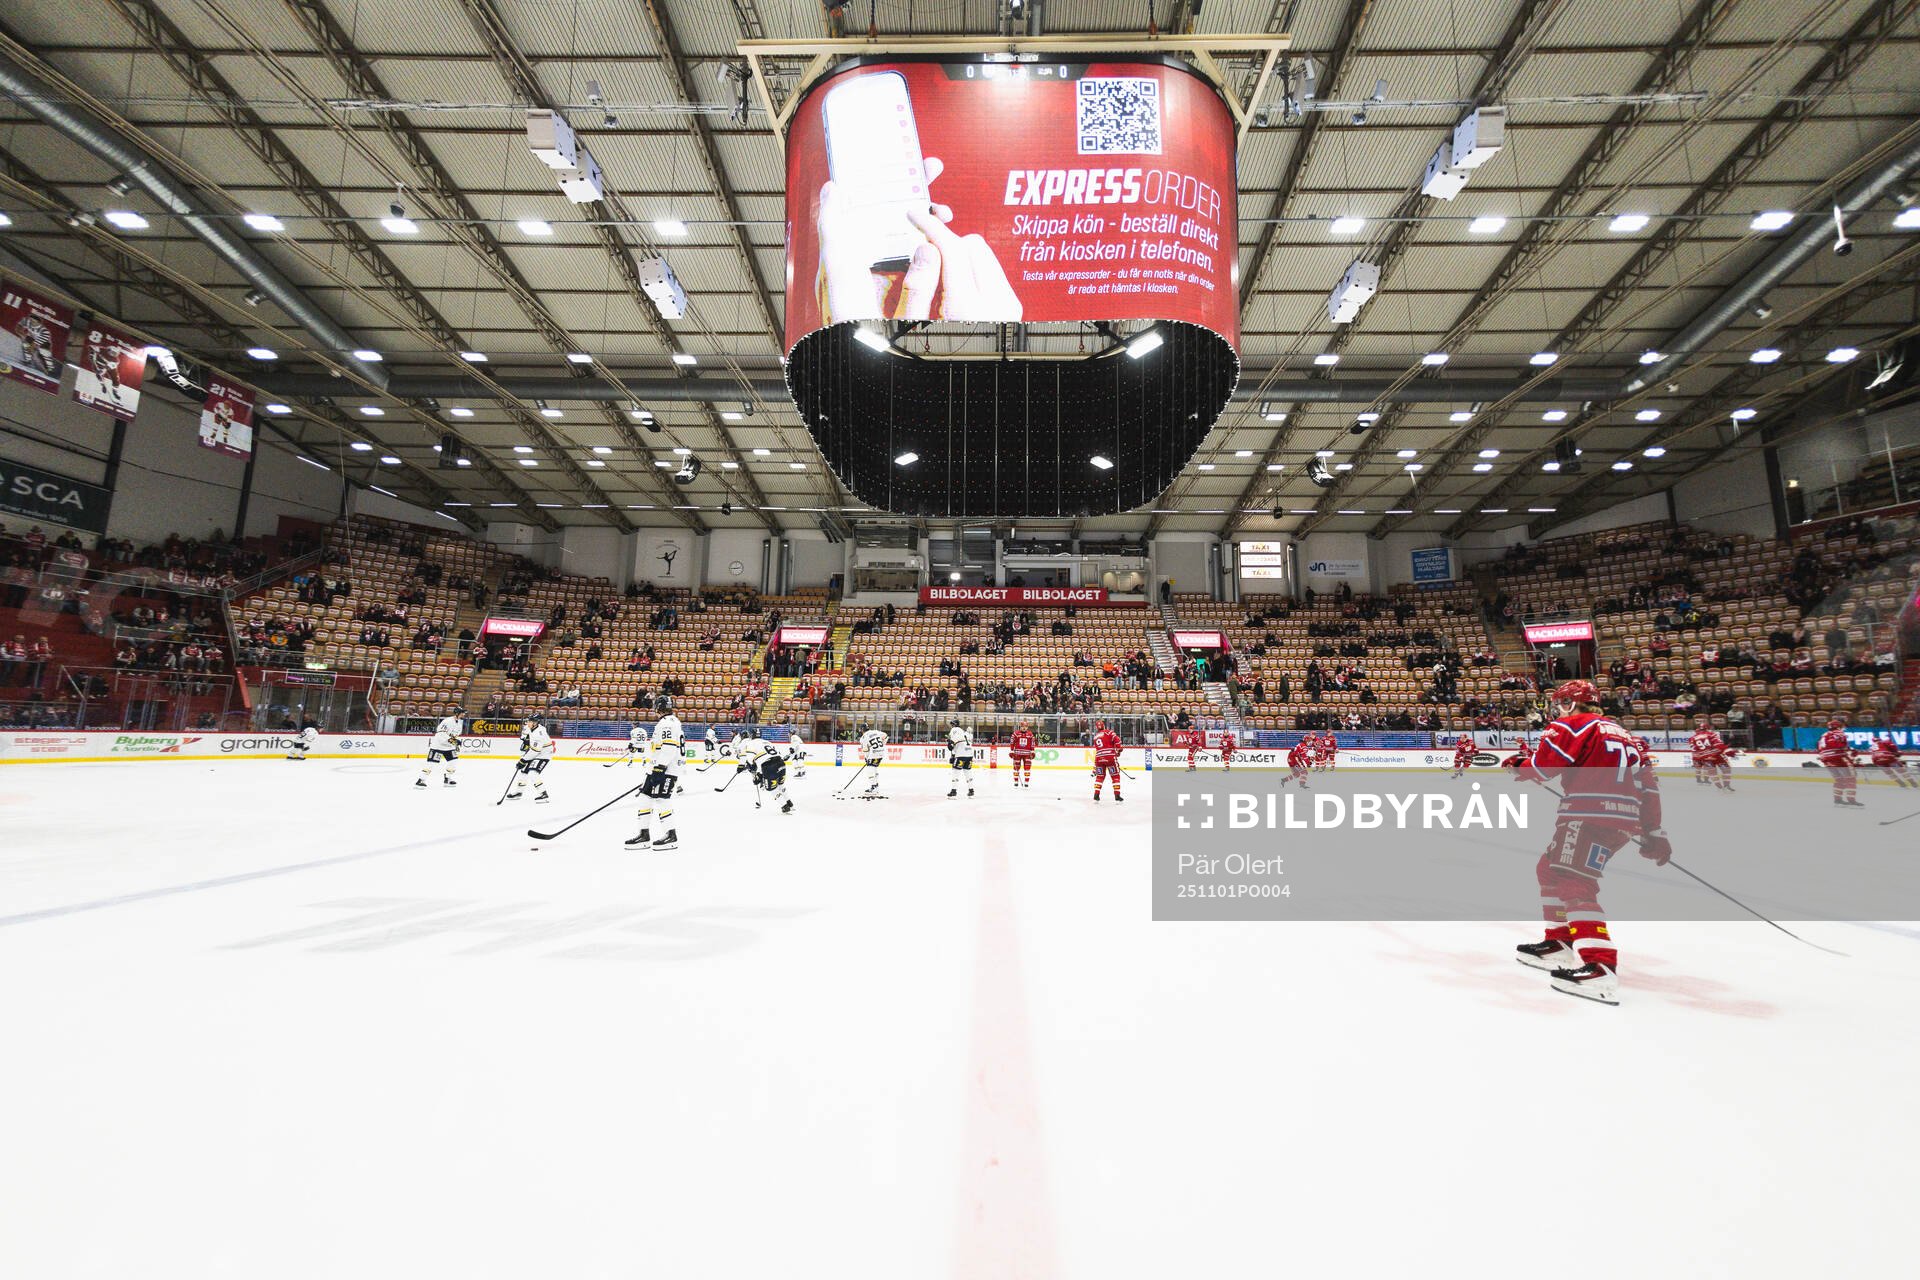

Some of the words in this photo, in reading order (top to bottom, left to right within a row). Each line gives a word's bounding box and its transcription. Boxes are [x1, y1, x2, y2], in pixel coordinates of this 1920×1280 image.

[1012, 214, 1068, 238] Skippa
[1073, 213, 1104, 234] kön
[1120, 213, 1177, 234] beställ
[1180, 218, 1219, 251] direkt
[1020, 241, 1055, 262] från
[1059, 240, 1126, 261] kiosken
[1130, 240, 1136, 259] i
[1140, 240, 1214, 273] telefonen.
[1023, 270, 1043, 281] Testa
[1044, 271, 1058, 281] vår
[1059, 270, 1110, 281] expressorder
[1118, 269, 1128, 279] du
[1129, 269, 1141, 279] får
[1143, 270, 1153, 279] en
[1154, 269, 1173, 280] notis
[1174, 270, 1187, 281] när
[1187, 272, 1199, 283] din
[1199, 275, 1215, 292] order
[1068, 284, 1077, 295] är
[1078, 284, 1097, 294] redo
[1098, 284, 1110, 294] att
[1111, 283, 1141, 293] hämtas
[4, 292, 22, 309] 11
[88, 331, 102, 343] 8
[210, 383, 226, 397] 21
[11, 476, 84, 510] SCA
[930, 589, 1008, 600] BILBOLAGET
[1023, 590, 1101, 601] BILBOLAGET
[115, 736, 178, 746] Byberg
[221, 736, 295, 753] granito
[868, 736, 884, 750] 55
[1695, 738, 1712, 750] 94
[1213, 753, 1276, 763] BIBOLAGET
[1350, 755, 1406, 763] Handelsbanken
